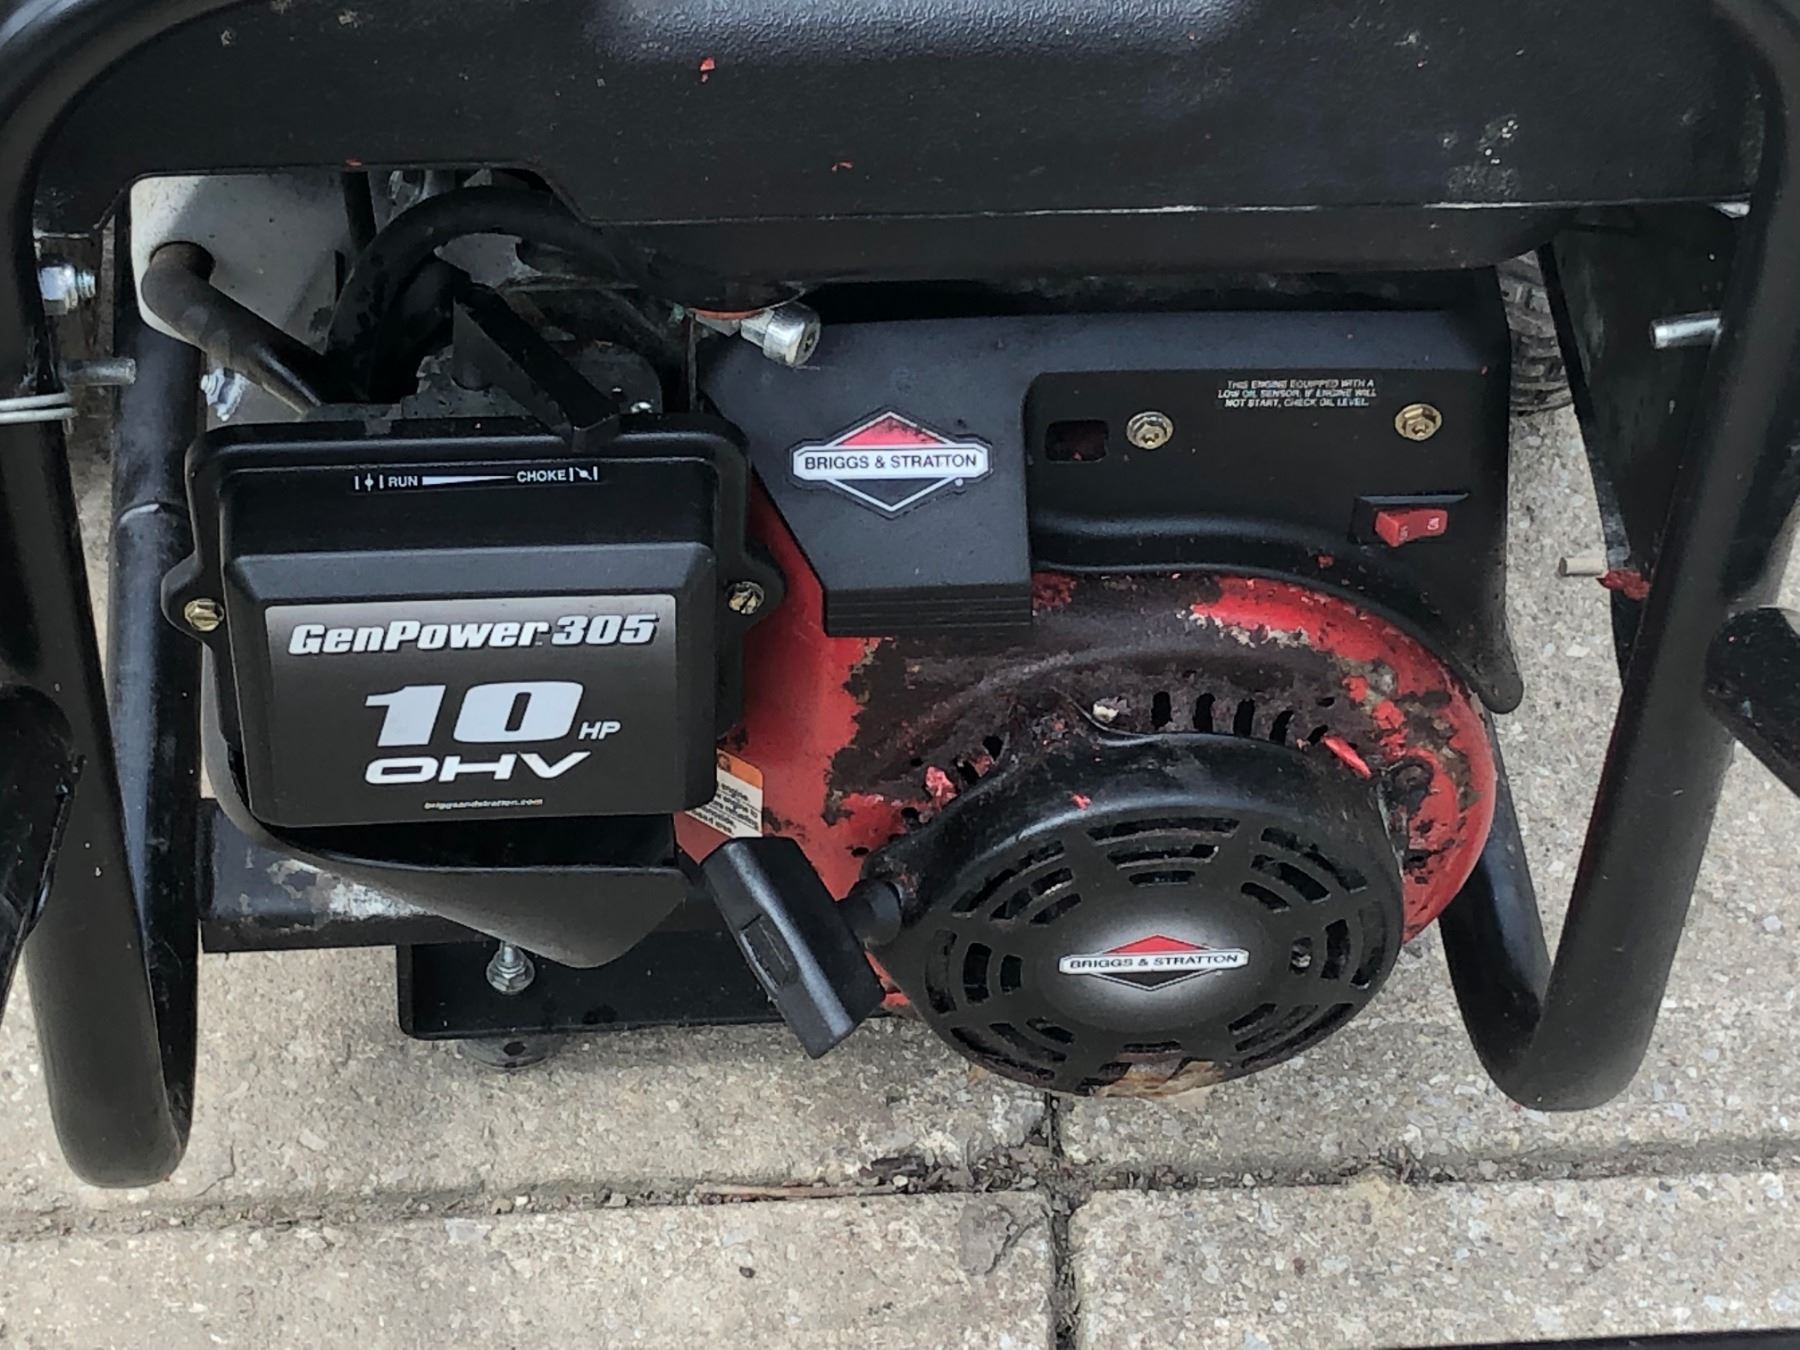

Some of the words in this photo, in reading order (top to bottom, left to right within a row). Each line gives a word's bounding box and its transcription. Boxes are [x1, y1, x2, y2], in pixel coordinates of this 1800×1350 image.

[1227, 380, 1249, 389] THIS
[1251, 380, 1288, 389] ENGINE
[1290, 379, 1338, 389] EQUIPPED
[1341, 379, 1365, 388] WITH
[1366, 379, 1375, 388] A
[1218, 389, 1240, 398] LOW
[1242, 389, 1257, 398] OIL
[1304, 389, 1313, 398] IF
[1316, 388, 1352, 398] ENGINE
[1355, 388, 1377, 397] WILL
[1225, 399, 1245, 408] NOT
[1283, 399, 1317, 408] CHECK
[1319, 398, 1335, 407] OIL
[804, 456, 870, 470] BRIGGS
[874, 456, 885, 469] &
[890, 453, 977, 468] STRATTON
[388, 476, 419, 488] RUN
[516, 469, 567, 483] CHOKE
[288, 621, 550, 655] GenPower
[551, 614, 660, 646] 305
[365, 681, 584, 747] 10
[578, 720, 622, 741] HP
[364, 751, 592, 785] OHV
[1070, 958, 1133, 969] BRIGGS
[1137, 957, 1150, 967] &
[1153, 954, 1238, 967] STRATTON
